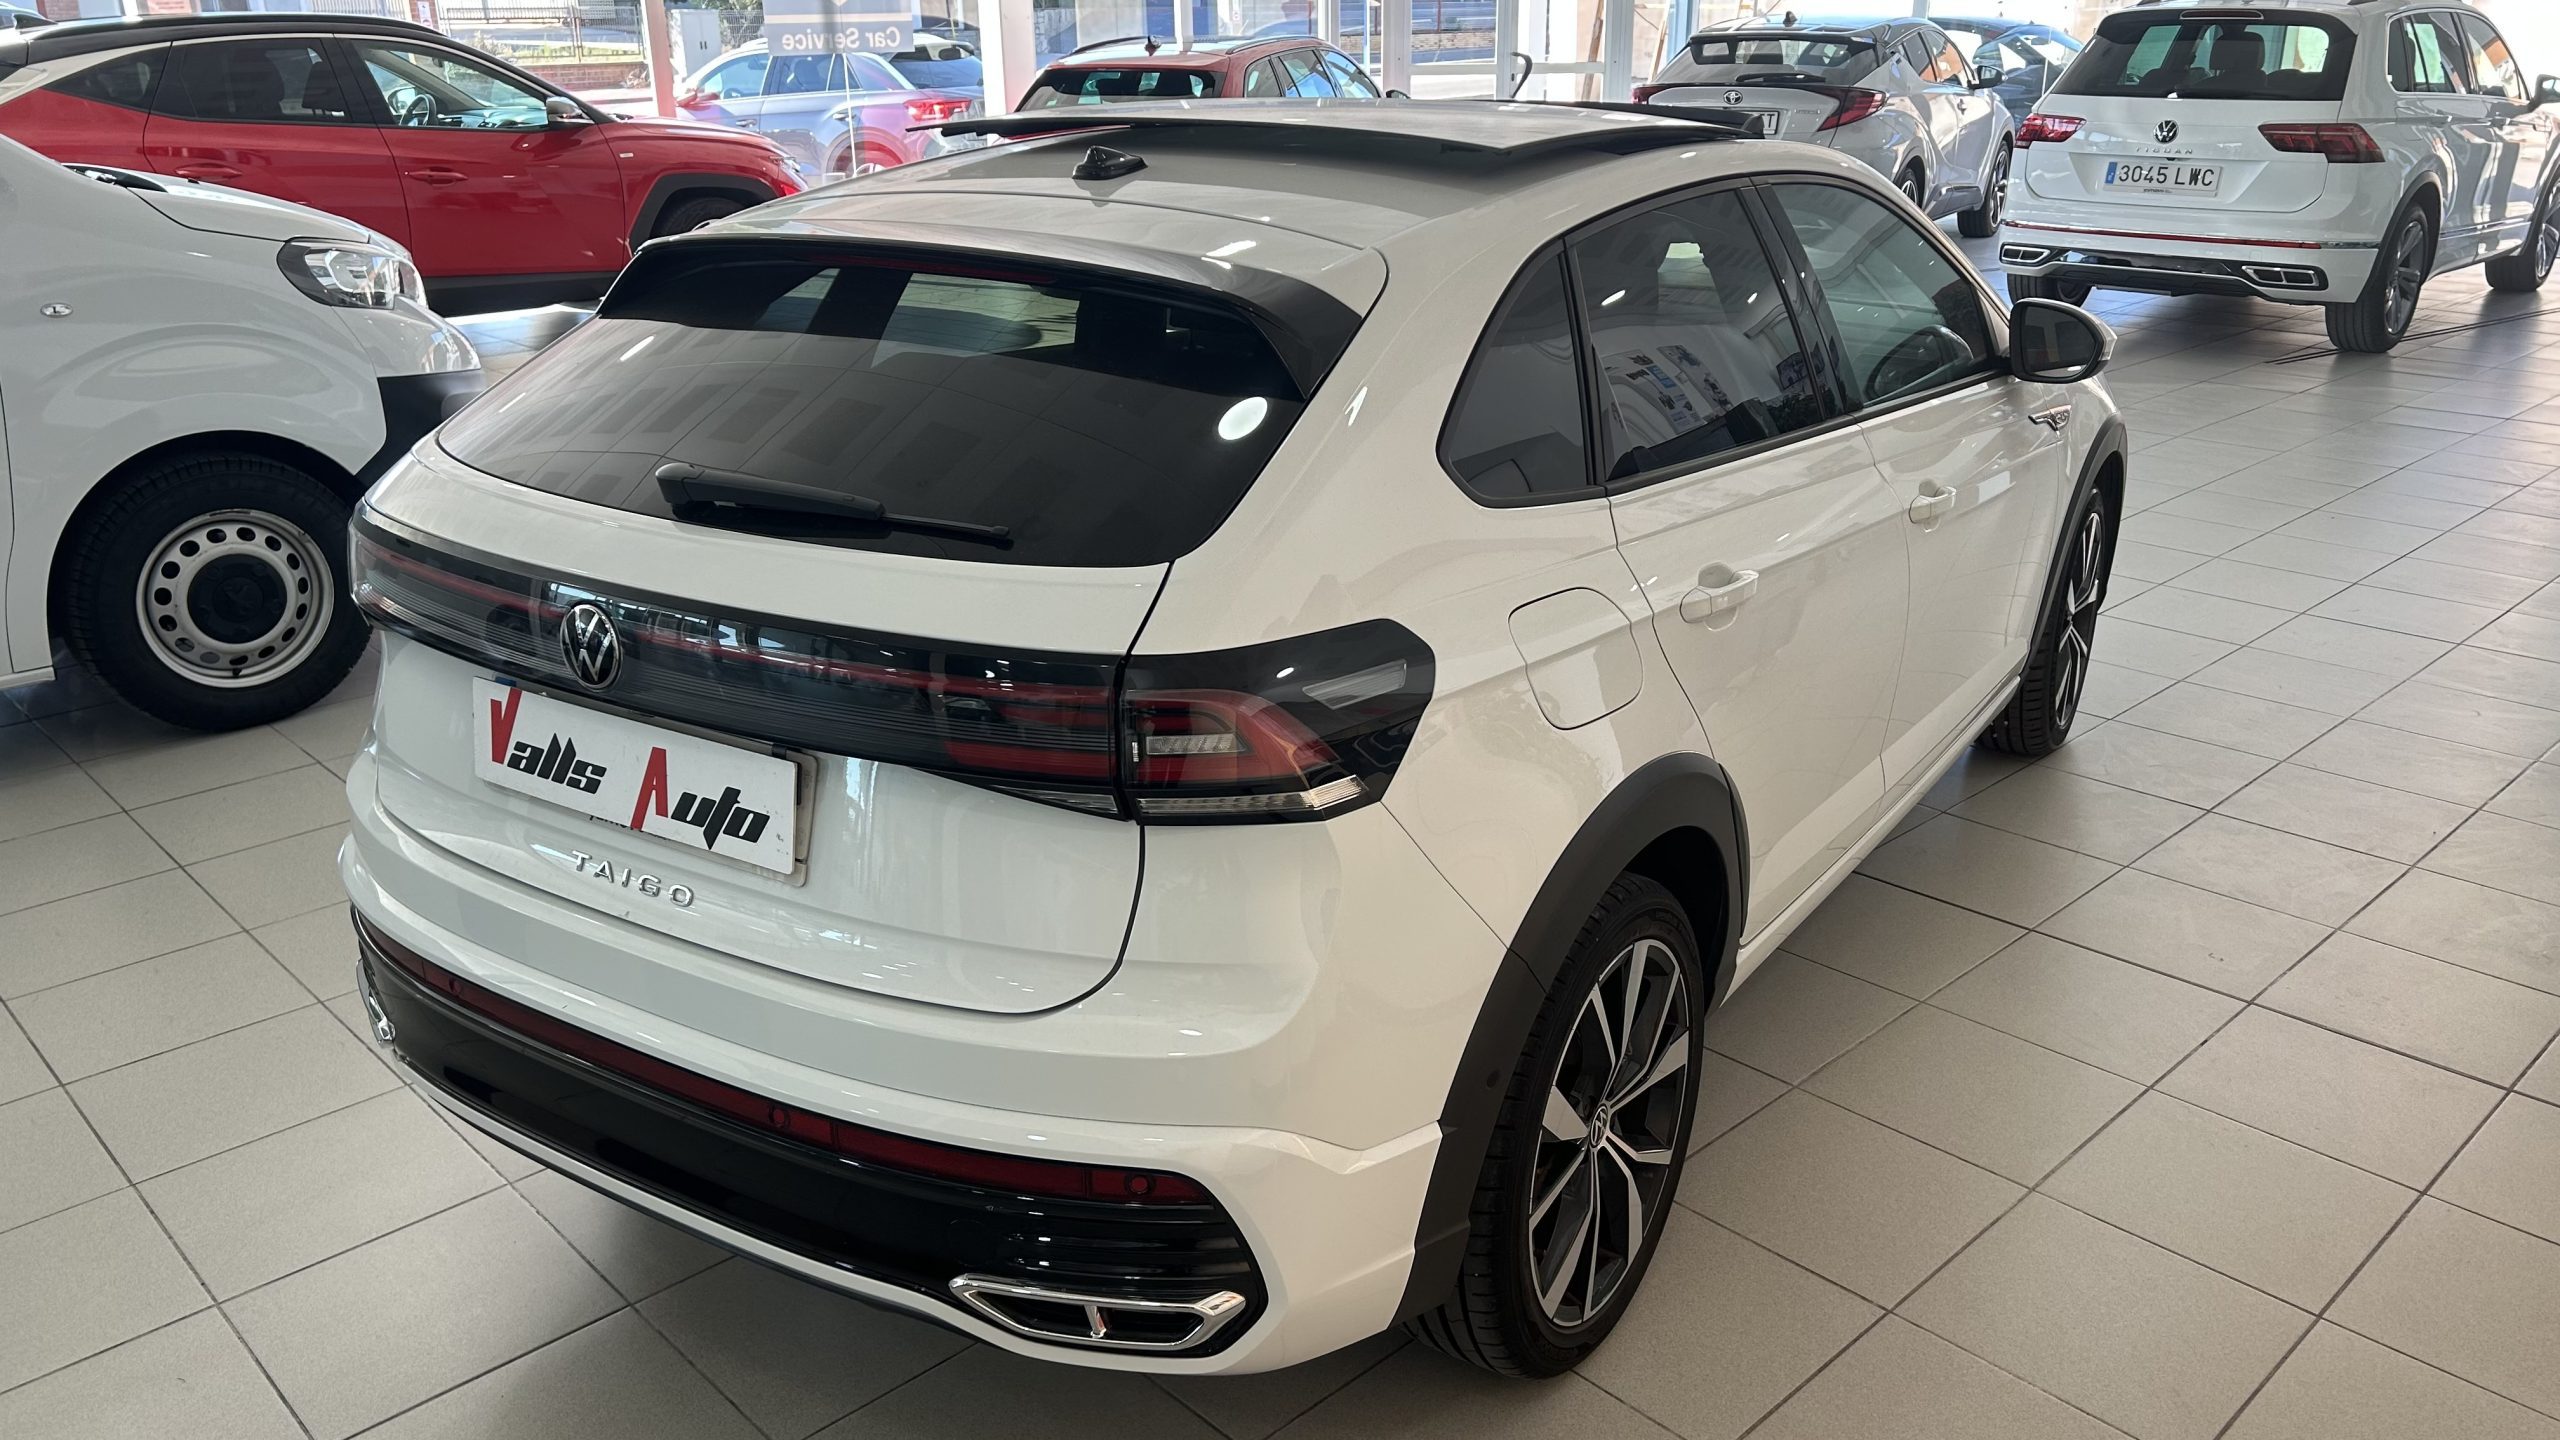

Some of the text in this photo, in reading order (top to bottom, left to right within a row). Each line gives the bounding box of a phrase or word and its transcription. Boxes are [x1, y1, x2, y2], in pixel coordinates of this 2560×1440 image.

[2118, 165, 2215, 187] 3045 LWC
[489, 687, 771, 851] Valls Auto
[571, 850, 695, 908] TAIGO
